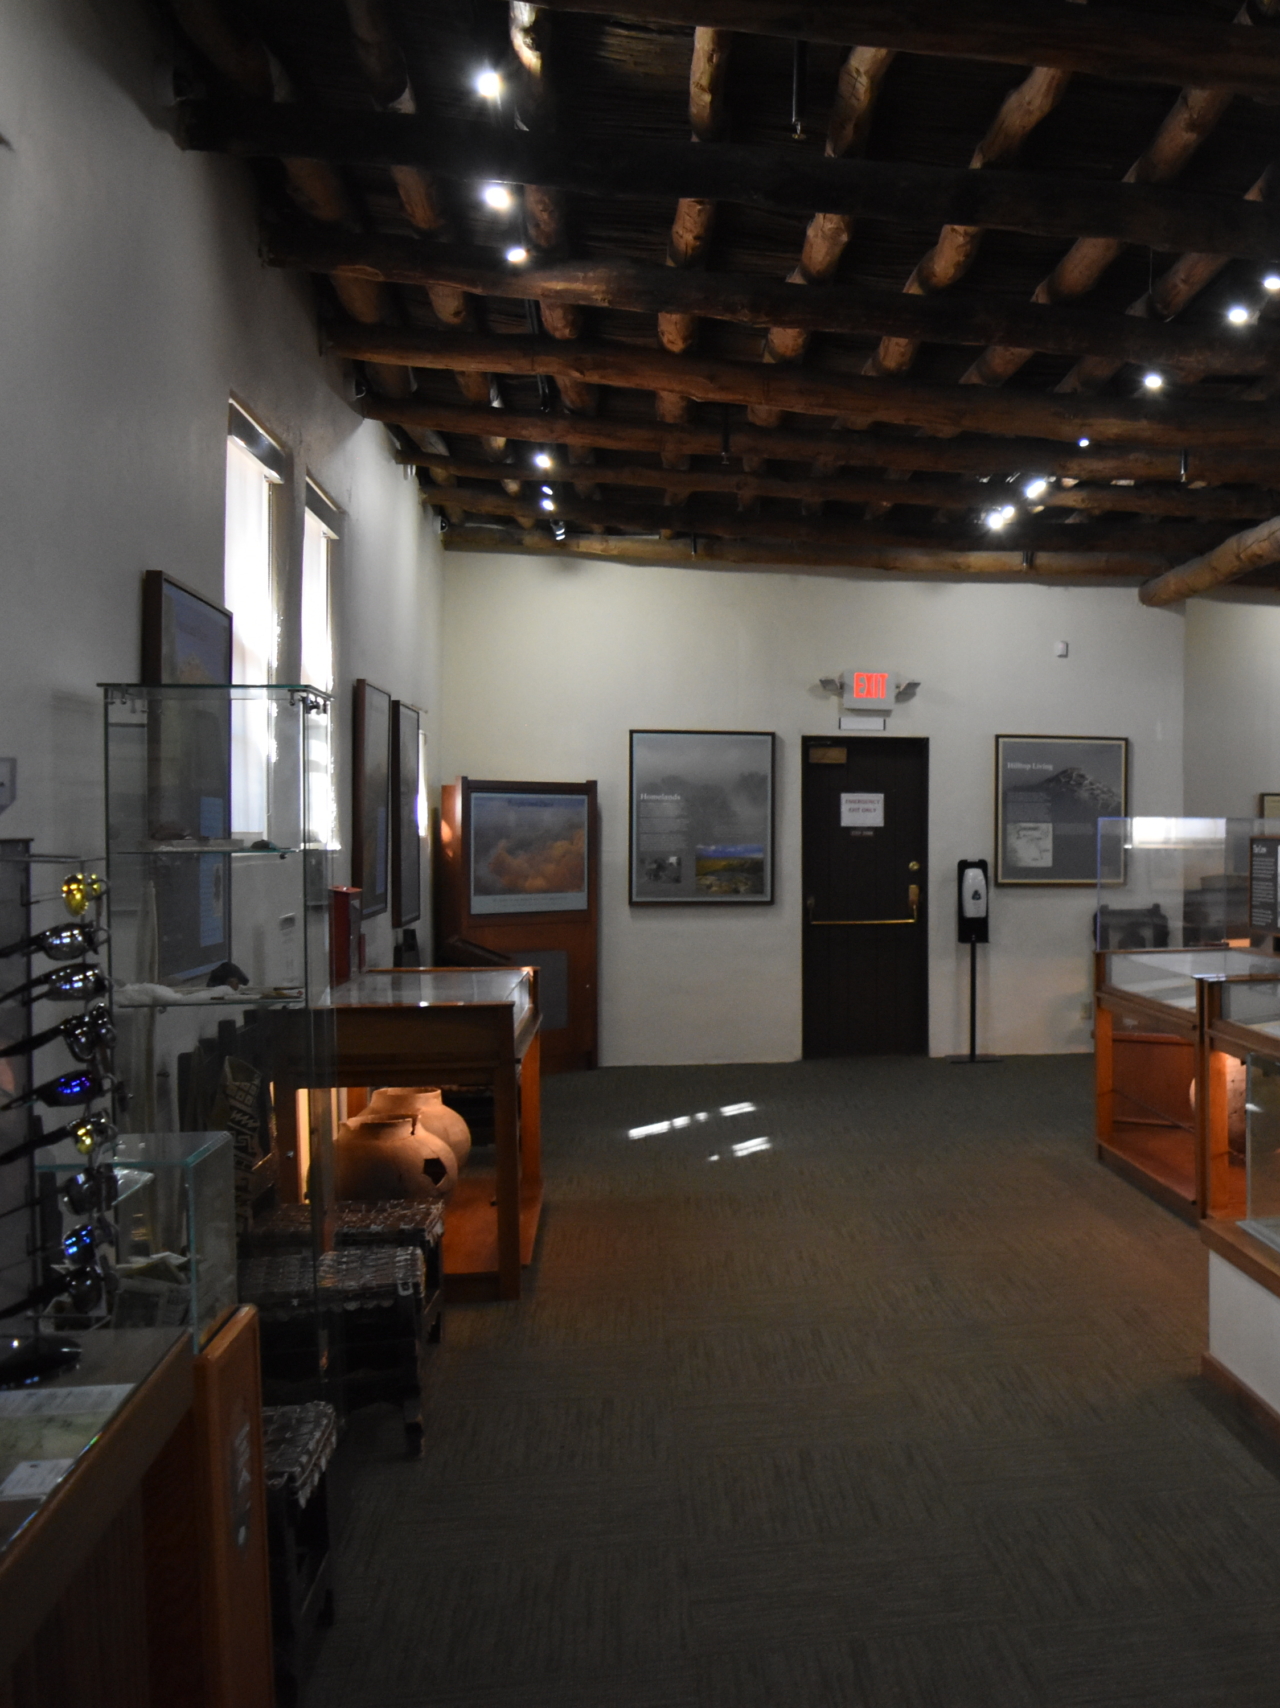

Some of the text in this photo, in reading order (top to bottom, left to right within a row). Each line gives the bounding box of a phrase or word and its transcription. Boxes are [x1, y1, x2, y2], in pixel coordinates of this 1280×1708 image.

[854, 672, 889, 699] EXIT
[1007, 762, 1053, 771] Hilltop Living
[640, 793, 681, 801] Homelands
